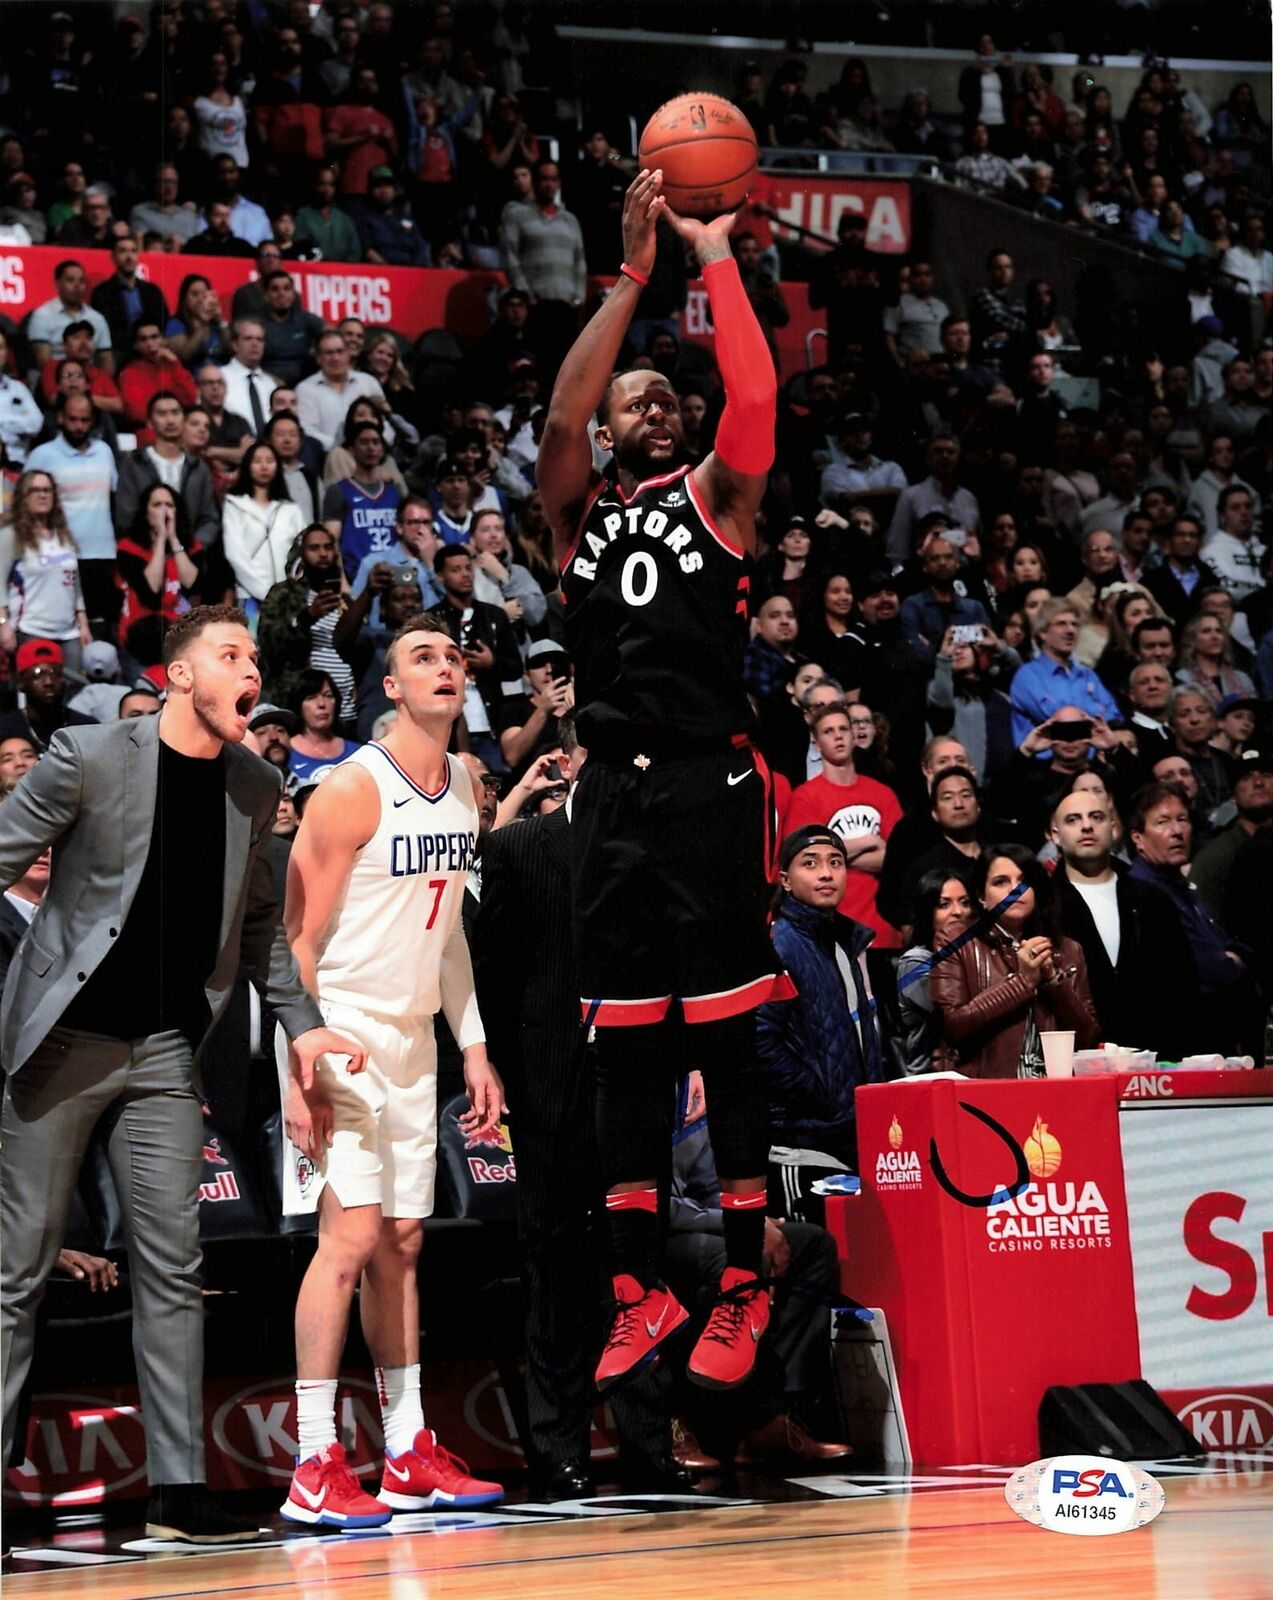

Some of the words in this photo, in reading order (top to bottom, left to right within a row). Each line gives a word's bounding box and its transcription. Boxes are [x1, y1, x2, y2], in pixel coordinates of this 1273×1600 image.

[368, 527, 391, 551] 32
[573, 506, 703, 581] RAPTORS
[621, 551, 658, 606] 0
[390, 831, 475, 877] CLIPPERS
[425, 879, 448, 930] 7
[1122, 1074, 1174, 1097] ANC
[876, 1151, 921, 1171] AGUA
[876, 1170, 922, 1184] CALIENTE
[195, 1170, 240, 1201] ull
[986, 1181, 1109, 1217] AGUA
[986, 1214, 1111, 1239] CALIENTE
[988, 1239, 1043, 1252] CASINO
[1050, 1237, 1112, 1250] RESORTS
[1183, 1190, 1273, 1322] S
[1191, 1408, 1265, 1447] KIA
